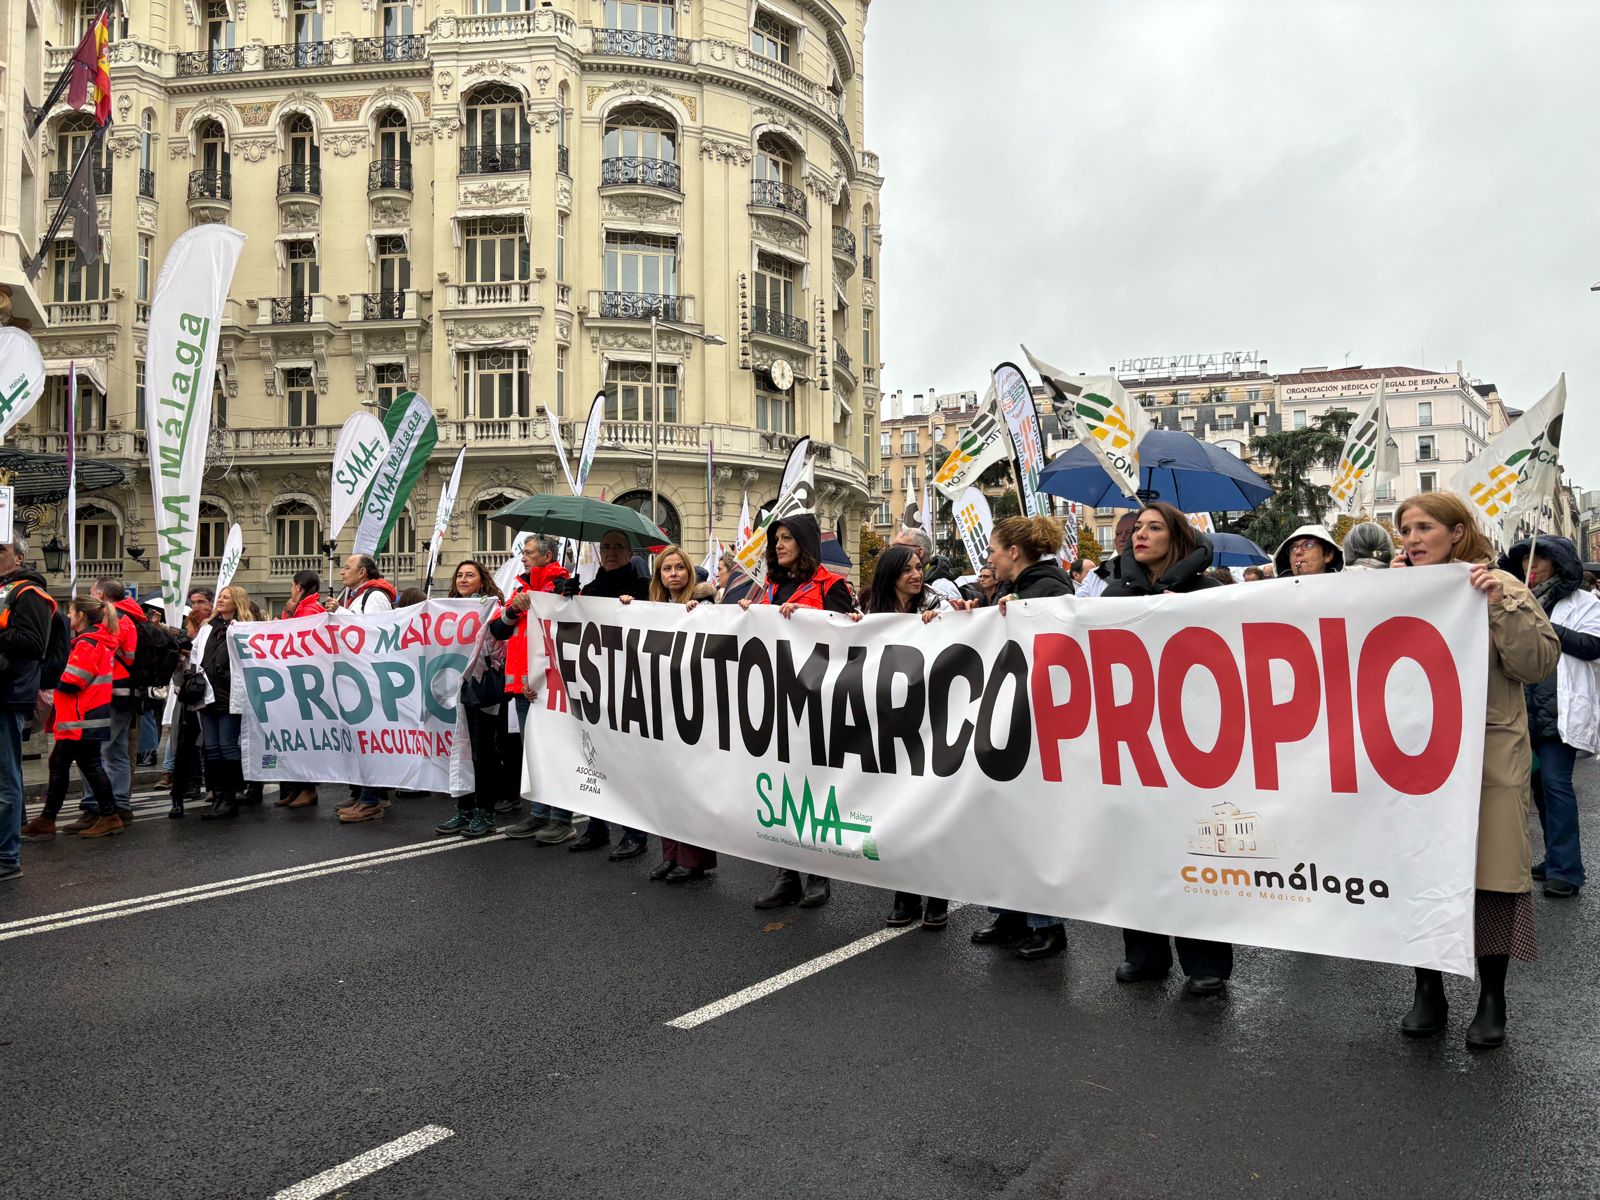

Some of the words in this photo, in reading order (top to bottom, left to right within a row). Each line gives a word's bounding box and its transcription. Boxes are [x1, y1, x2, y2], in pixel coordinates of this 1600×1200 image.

[1121, 356, 1167, 372] HOTEL
[1172, 353, 1215, 367] VILLA
[1286, 385, 1338, 395] ORGANIZACIÓN
[1370, 380, 1406, 389] COEGIAL
[1408, 379, 1419, 387] DE
[1421, 377, 1449, 386] ESPAÑA
[156, 311, 206, 480] Málaga
[336, 440, 381, 496] SMA
[368, 472, 399, 521] SMA
[387, 410, 422, 473] Málaga
[233, 624, 366, 660] ESTATUTO
[374, 611, 481, 654] MARCO
[243, 653, 469, 725] PROPIO
[756, 771, 871, 847] SMA
[849, 811, 873, 824] Málaga
[1183, 885, 1230, 897] Colegio
[1259, 891, 1313, 903] Médicos
